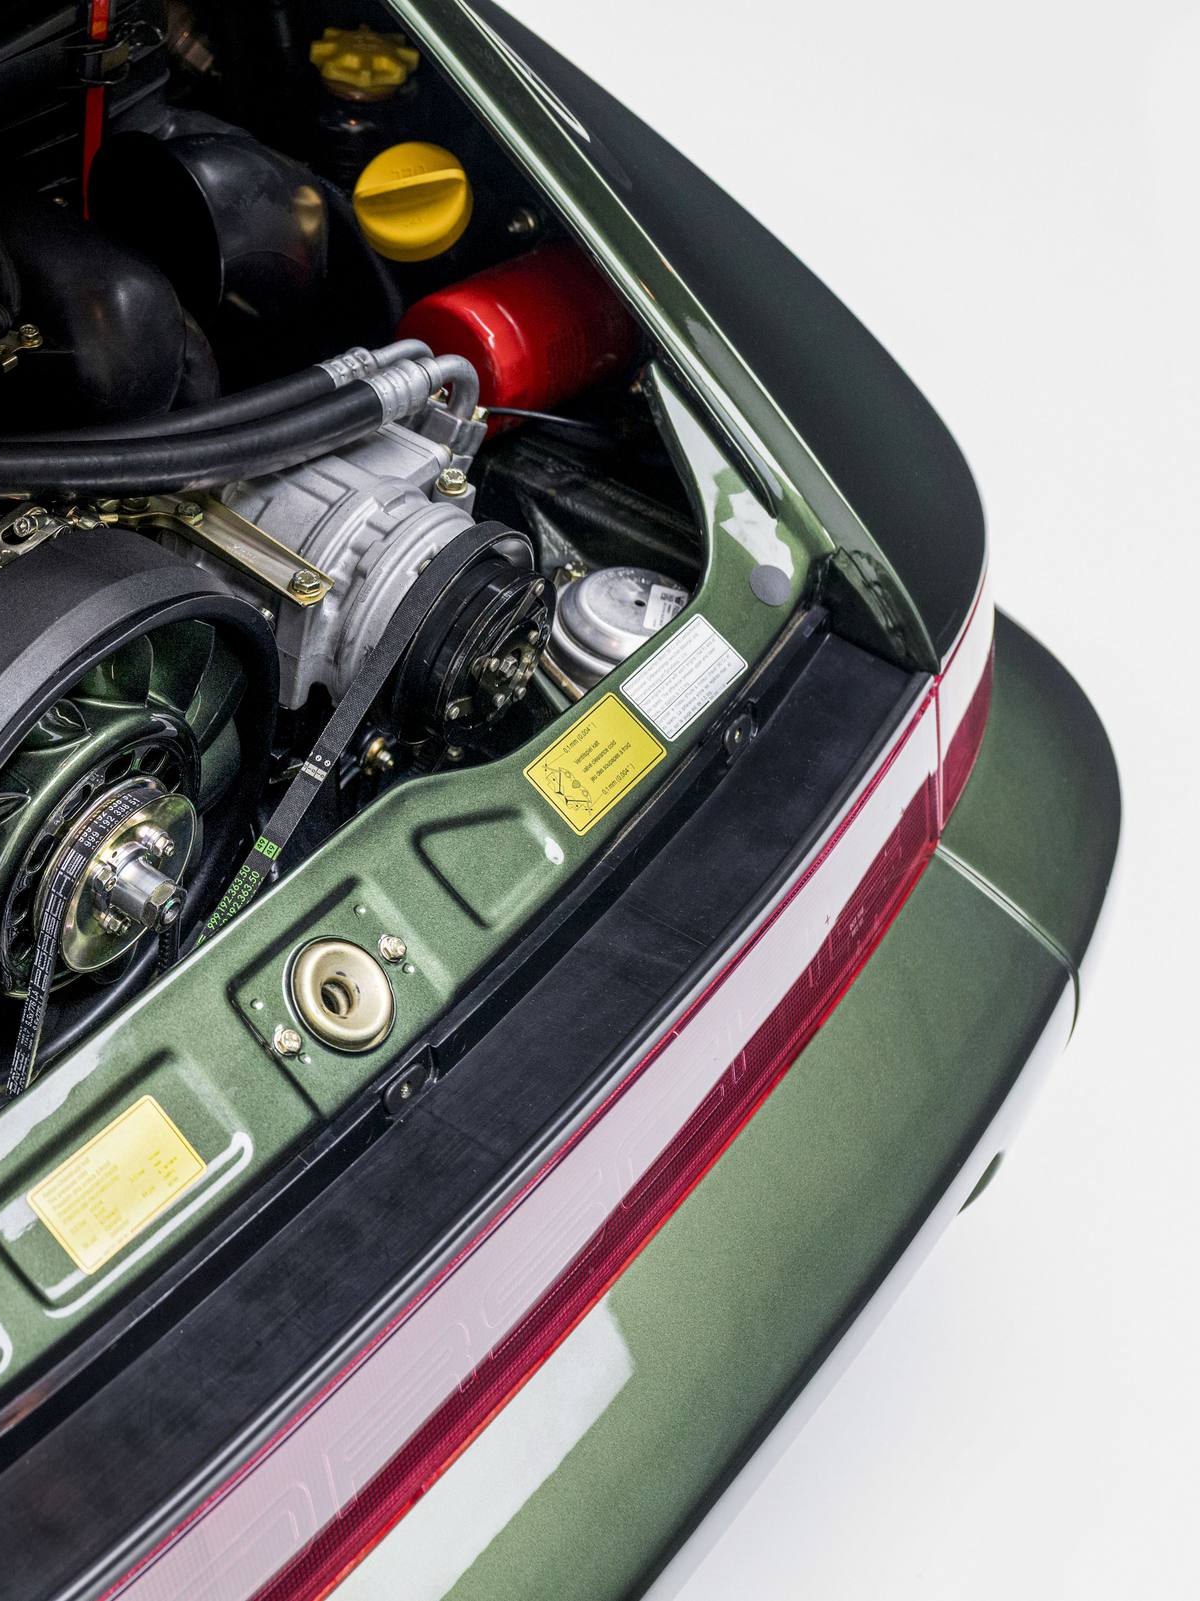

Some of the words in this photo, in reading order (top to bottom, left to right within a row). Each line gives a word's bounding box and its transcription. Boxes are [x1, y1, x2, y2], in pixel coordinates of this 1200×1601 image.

[82, 830, 101, 847] 999
[98, 814, 115, 829] 192
[114, 802, 129, 816] 338
[129, 796, 140, 806] 51
[255, 838, 266, 850] 49
[265, 844, 275, 855] 49
[207, 865, 250, 929] 999.192.363.50
